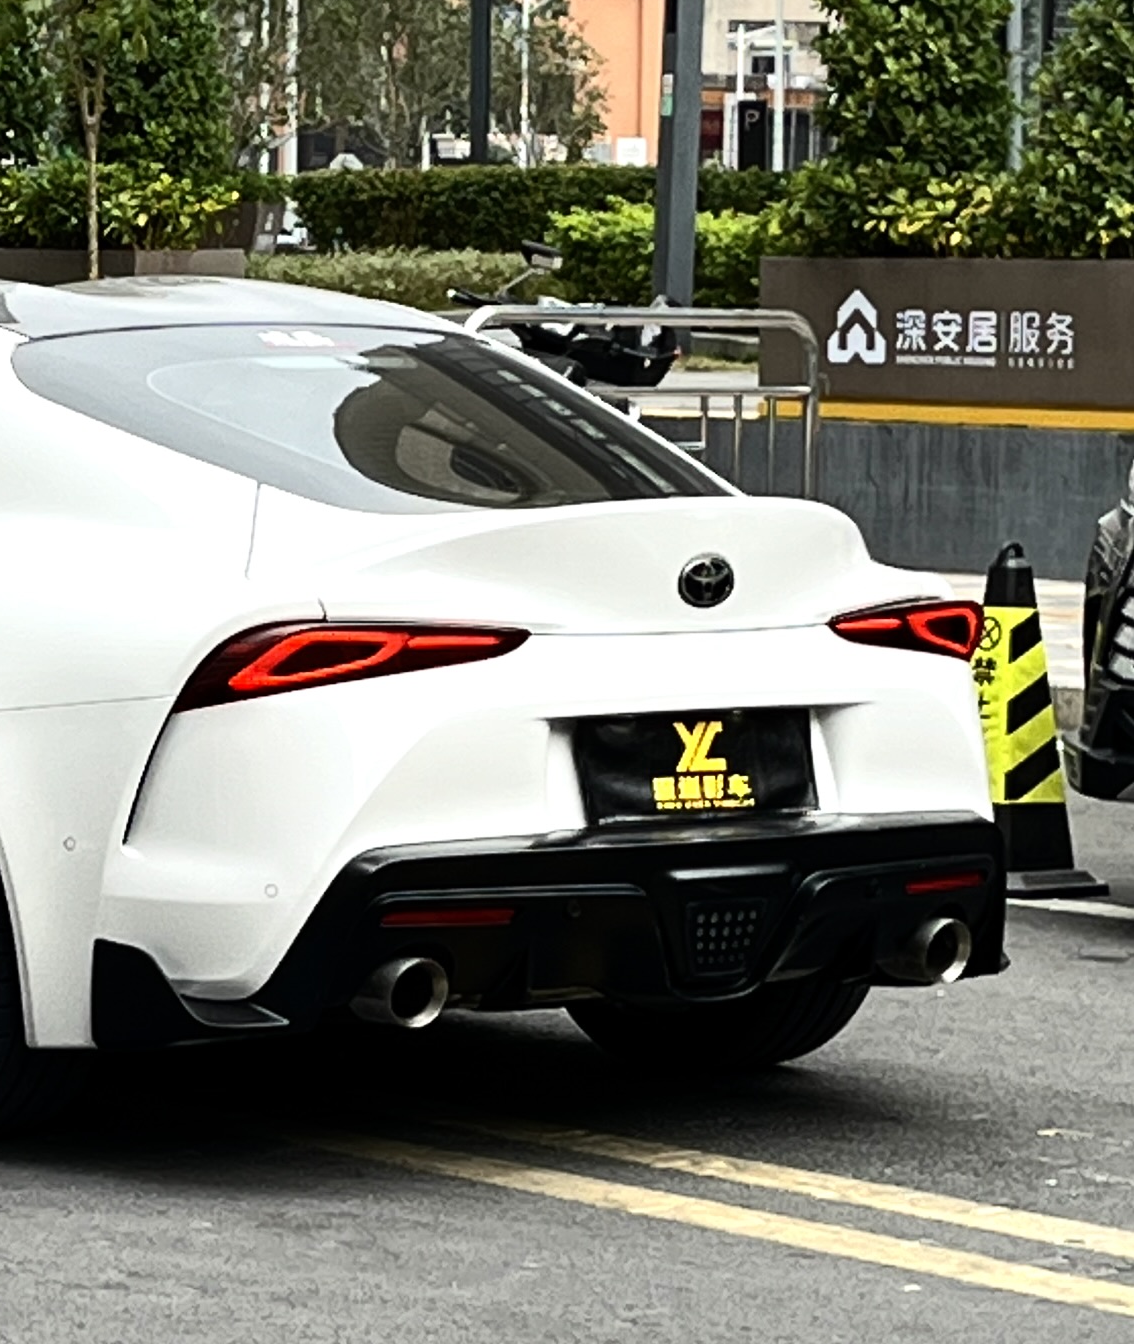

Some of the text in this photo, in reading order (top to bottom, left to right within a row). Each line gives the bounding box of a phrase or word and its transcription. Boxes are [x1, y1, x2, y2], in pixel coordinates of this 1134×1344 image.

[744, 109, 761, 131] P
[895, 309, 1075, 354] 深安居 服务
